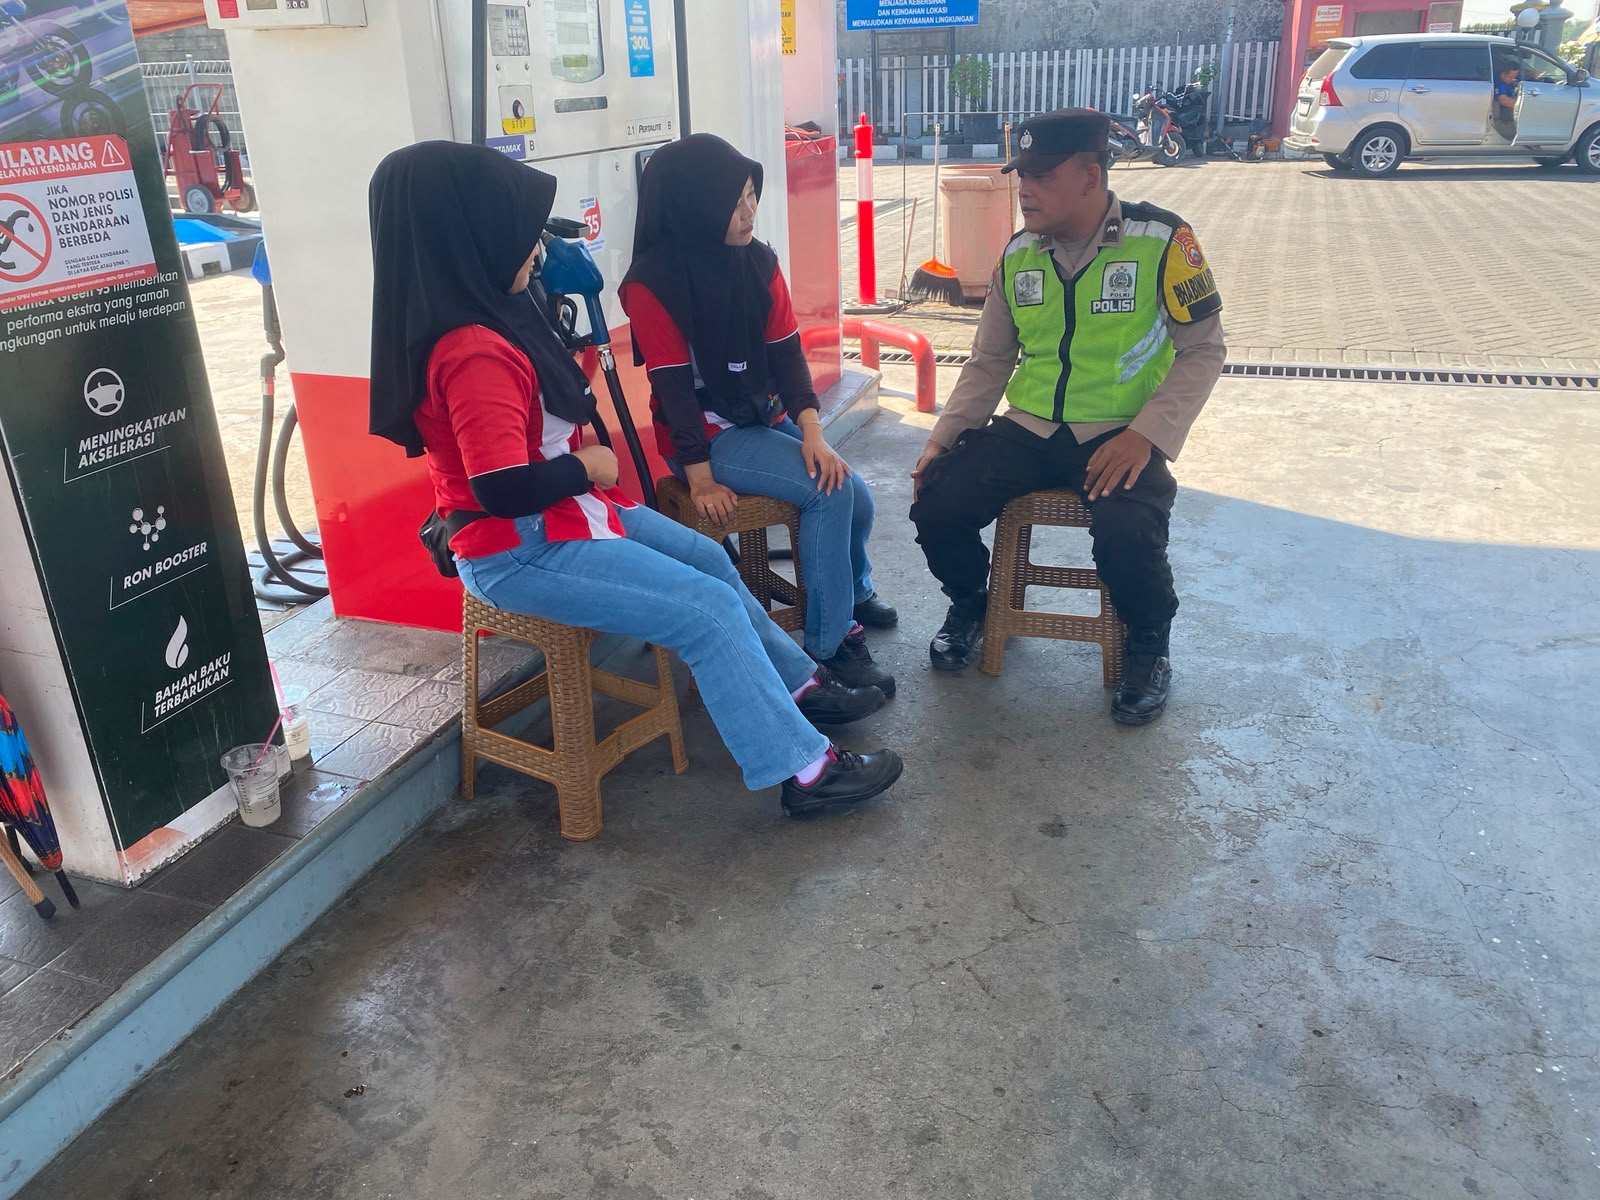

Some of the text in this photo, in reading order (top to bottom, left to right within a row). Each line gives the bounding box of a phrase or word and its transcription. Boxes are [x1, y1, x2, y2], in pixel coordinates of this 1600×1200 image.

[852, 15, 974, 27] MEWUJUDKAN KENYAMANAN LINGKUNGAN
[891, 8, 925, 16] KEINDAHAN
[926, 7, 948, 15] LOKASI
[511, 119, 527, 129] STOP
[667, 121, 672, 130] B
[529, 140, 535, 151] B
[0, 142, 94, 169] ILARANG
[0, 161, 97, 180] ELAYANI KENDARAAN
[46, 185, 69, 196] JIKA
[48, 188, 134, 210] NOMOR POLISI
[52, 204, 114, 223] DAN JENIS
[55, 214, 130, 236] KENDARAAN
[58, 230, 111, 249] BERBEDA
[65, 257, 86, 265] DENGAN
[100, 249, 129, 258] KENDARAAN
[66, 262, 81, 270] YANG
[74, 266, 90, 275] LAYAR
[113, 271, 179, 293] memberikan
[7, 287, 170, 334] performa ekstra yang ramah
[1092, 300, 1135, 313] POLISI
[0, 300, 186, 353] ngkungan untuk melaju terdepan
[78, 407, 187, 454] MENINGKATKAN
[78, 432, 155, 469] AKSELERASI
[123, 541, 207, 589] RON BOOSTER
[155, 651, 231, 704] BAHAN BAKU
[154, 665, 230, 718] TERBARUKAN
